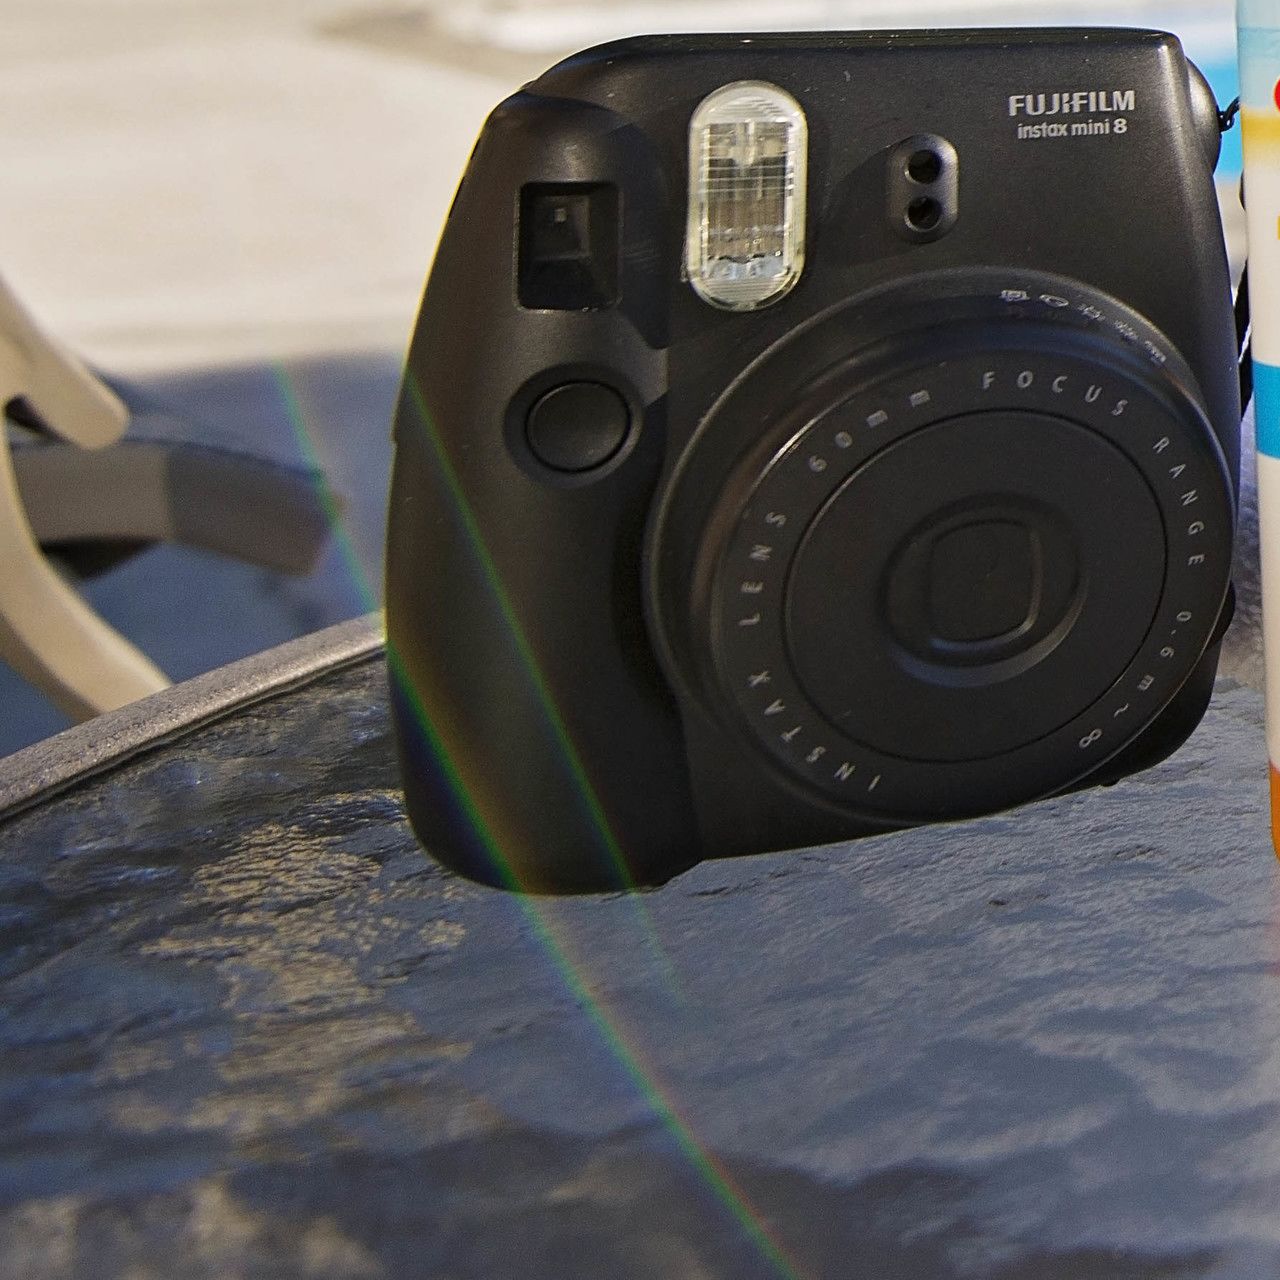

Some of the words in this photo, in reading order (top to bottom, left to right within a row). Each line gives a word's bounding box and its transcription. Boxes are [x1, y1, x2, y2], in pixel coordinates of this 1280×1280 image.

[1008, 90, 1136, 116] FUJIFILM
[1017, 122, 1068, 140] instax
[1071, 118, 1109, 136] mini
[1113, 118, 1128, 134] 8
[983, 370, 1128, 417] FOCUS
[1152, 435, 1205, 567] RANGE
[739, 511, 787, 627] LENS
[748, 670, 881, 791] INSTAX
